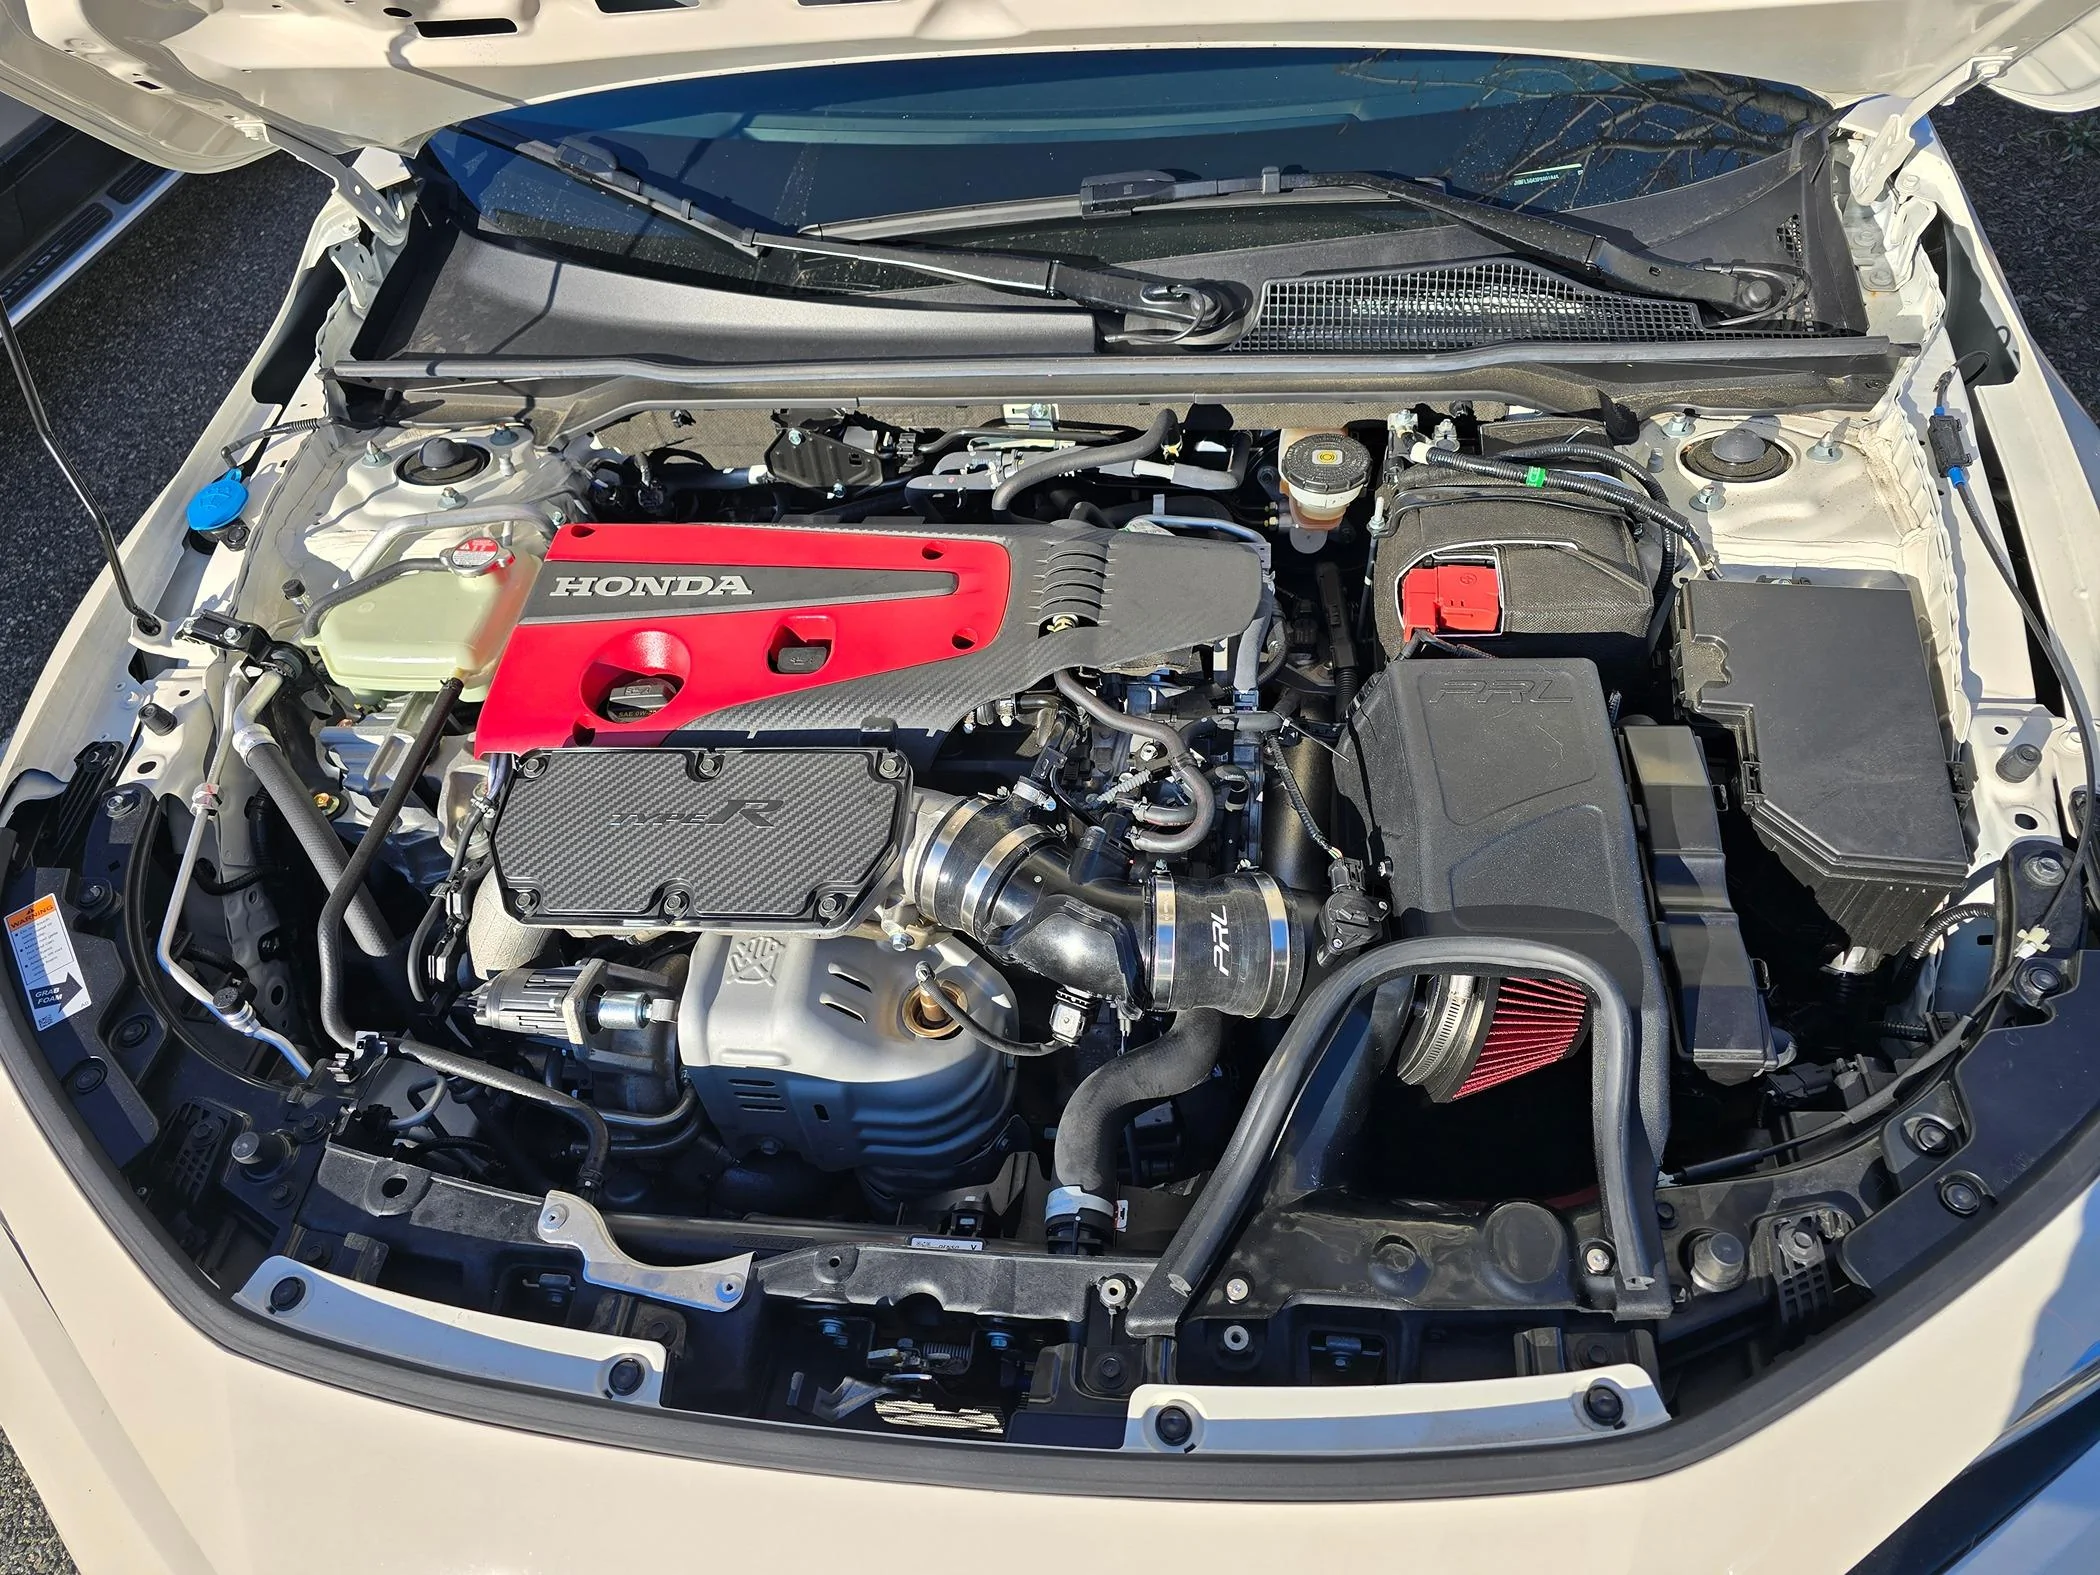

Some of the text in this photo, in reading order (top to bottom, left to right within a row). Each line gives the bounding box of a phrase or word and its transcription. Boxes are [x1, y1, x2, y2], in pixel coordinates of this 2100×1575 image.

[549, 575, 754, 597] HONDA
[1429, 679, 1574, 703] PRL
[609, 799, 784, 829] TYPE R
[10, 904, 54, 928] WARNING
[1210, 904, 1230, 977] PRL
[35, 987, 60, 998] GRAB
[37, 993, 63, 1005] FOAM
